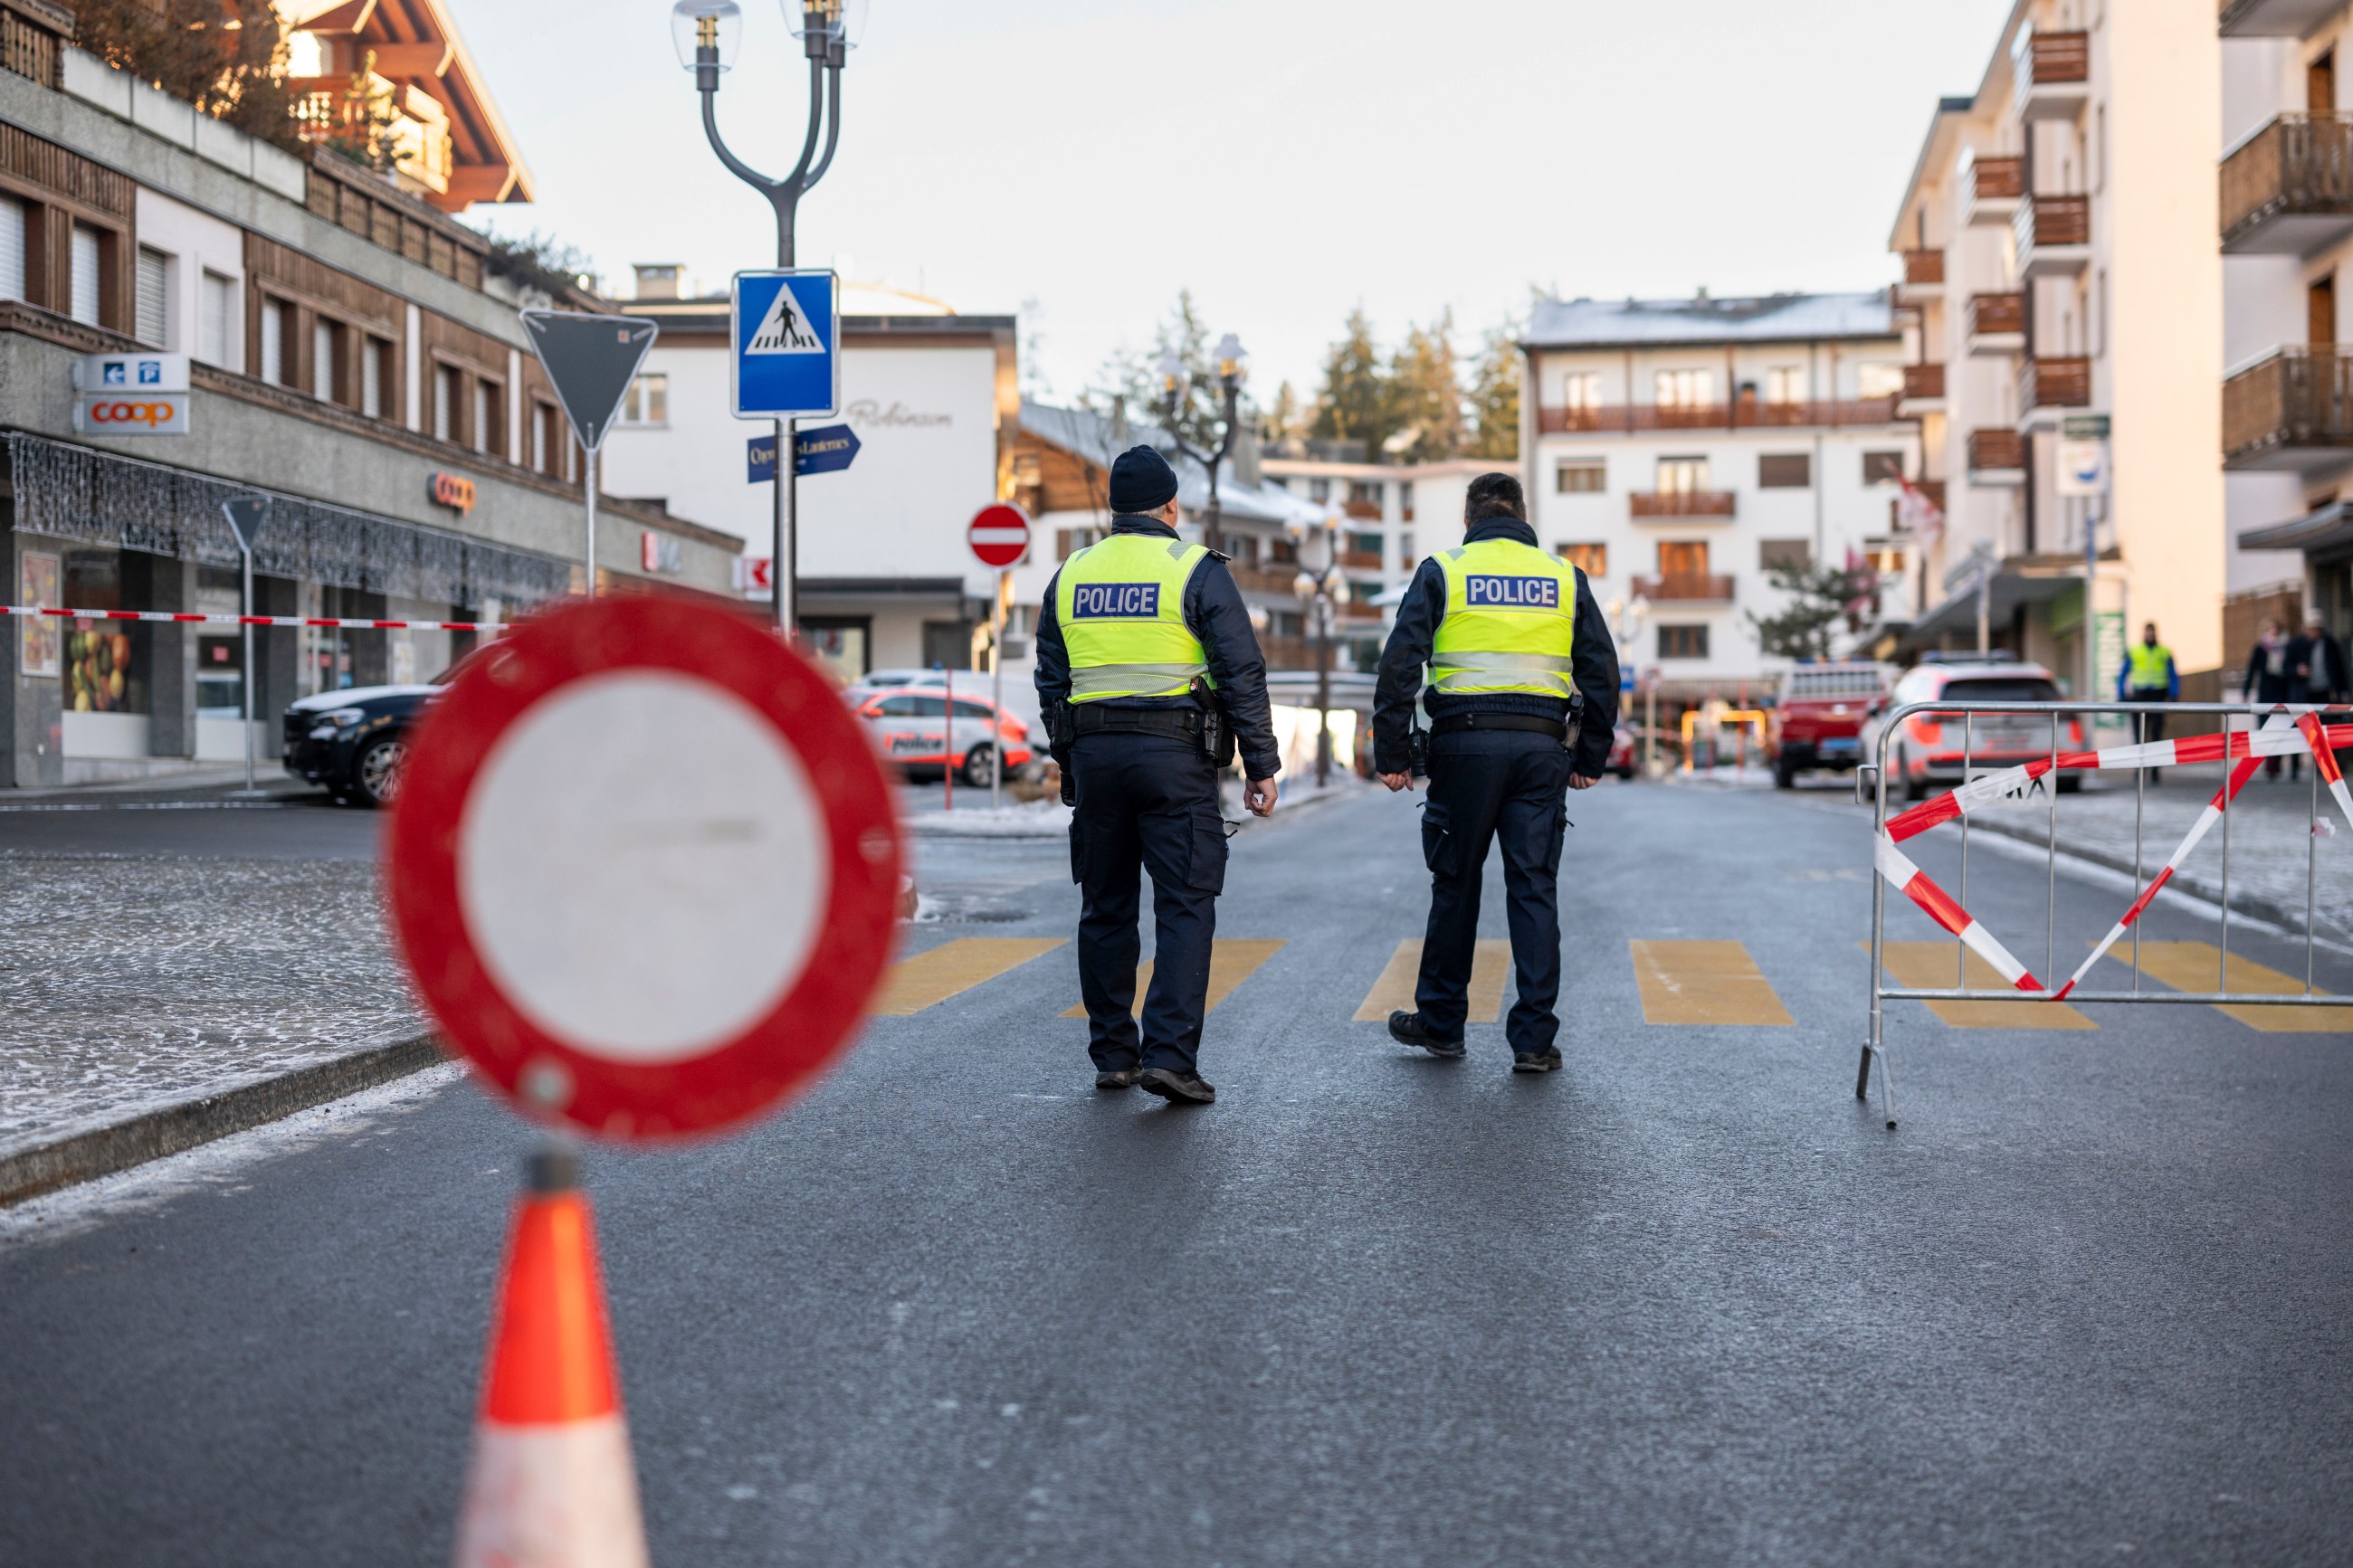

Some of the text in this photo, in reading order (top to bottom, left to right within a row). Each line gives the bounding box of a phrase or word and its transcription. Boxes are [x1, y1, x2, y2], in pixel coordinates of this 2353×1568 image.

[91, 401, 174, 429] coop
[845, 398, 953, 428] Robinson
[435, 471, 476, 518] coop
[1075, 586, 1157, 614] POLICE
[1470, 578, 1556, 604] POLICE
